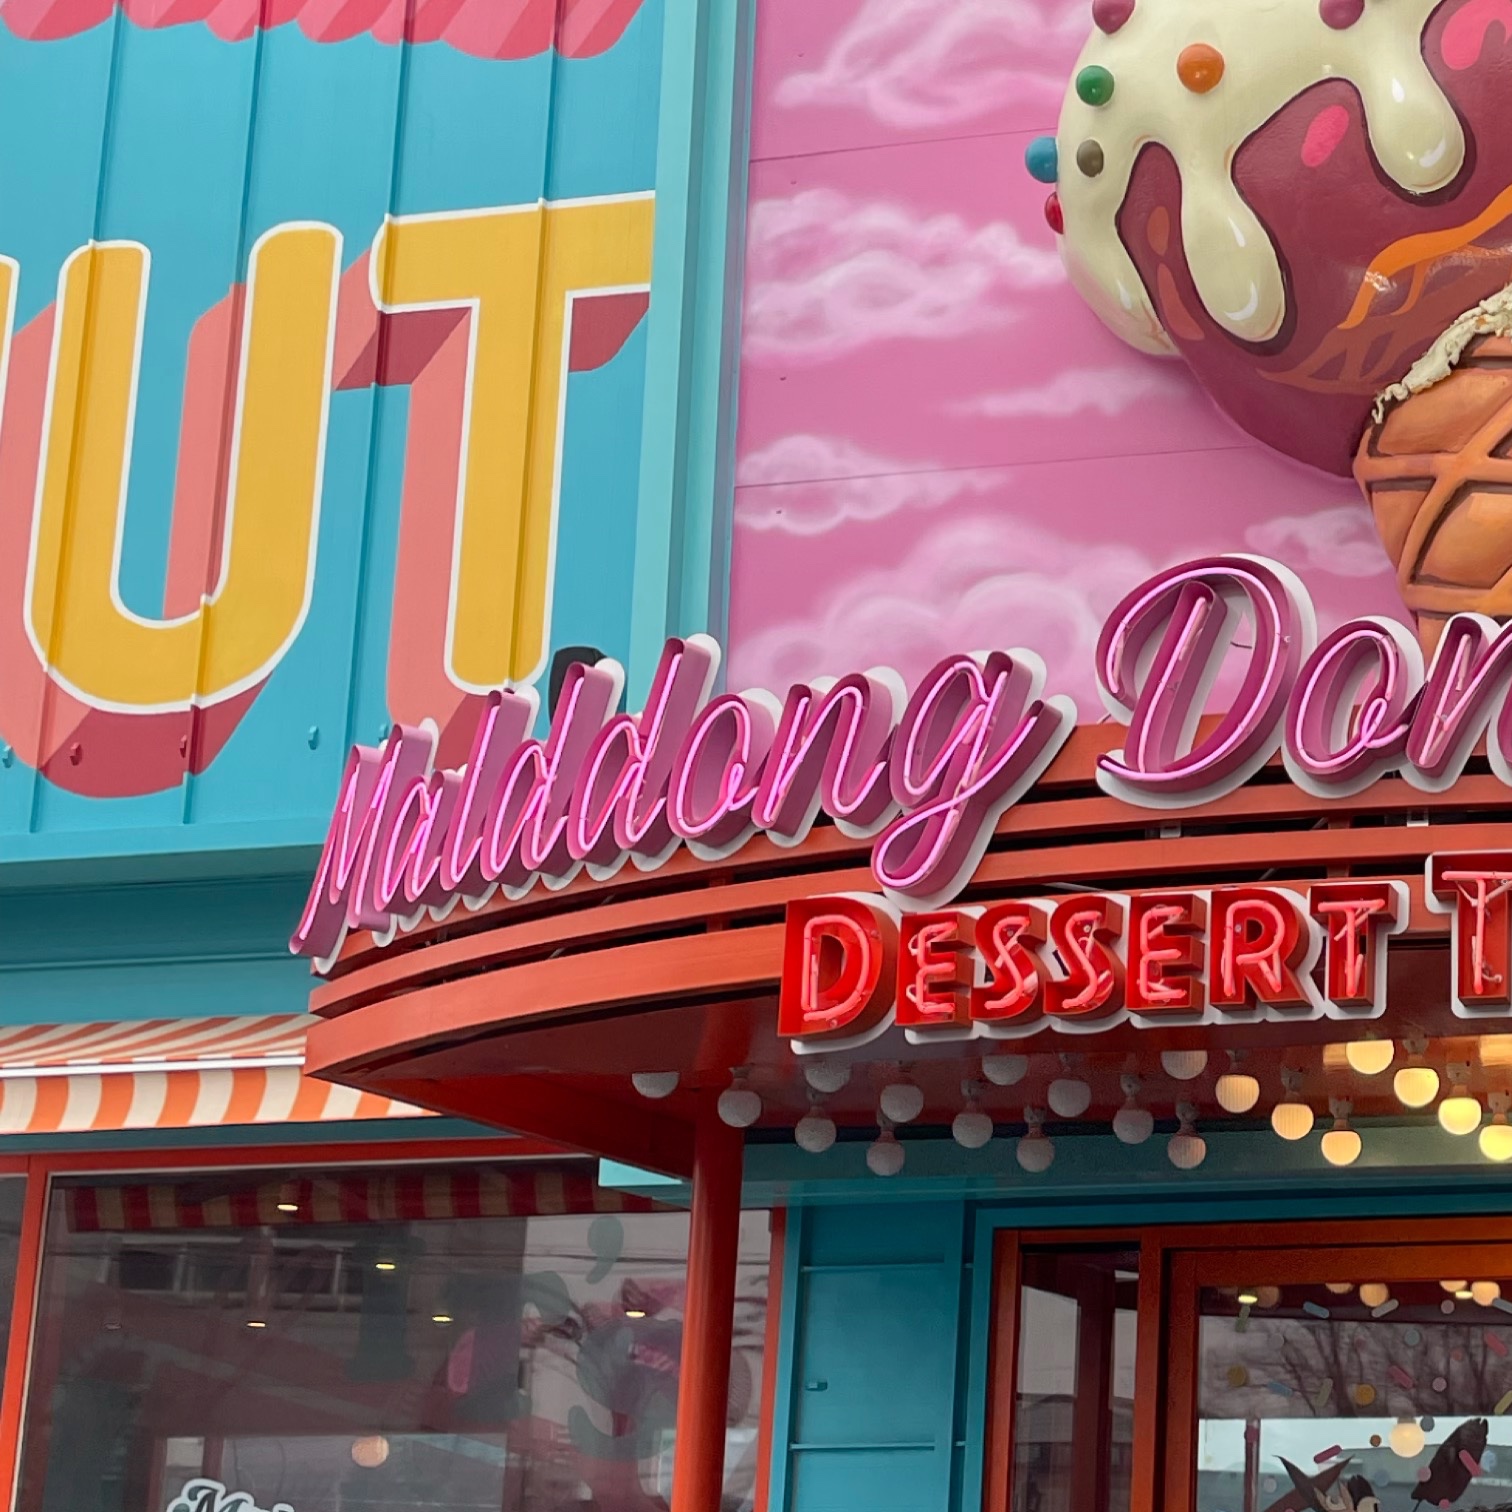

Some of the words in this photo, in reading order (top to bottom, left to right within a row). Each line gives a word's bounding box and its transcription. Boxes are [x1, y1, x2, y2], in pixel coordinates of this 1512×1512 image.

[0, 190, 656, 712] UT
[290, 633, 1076, 973] Malddong
[779, 881, 1410, 1054] DESSERT
